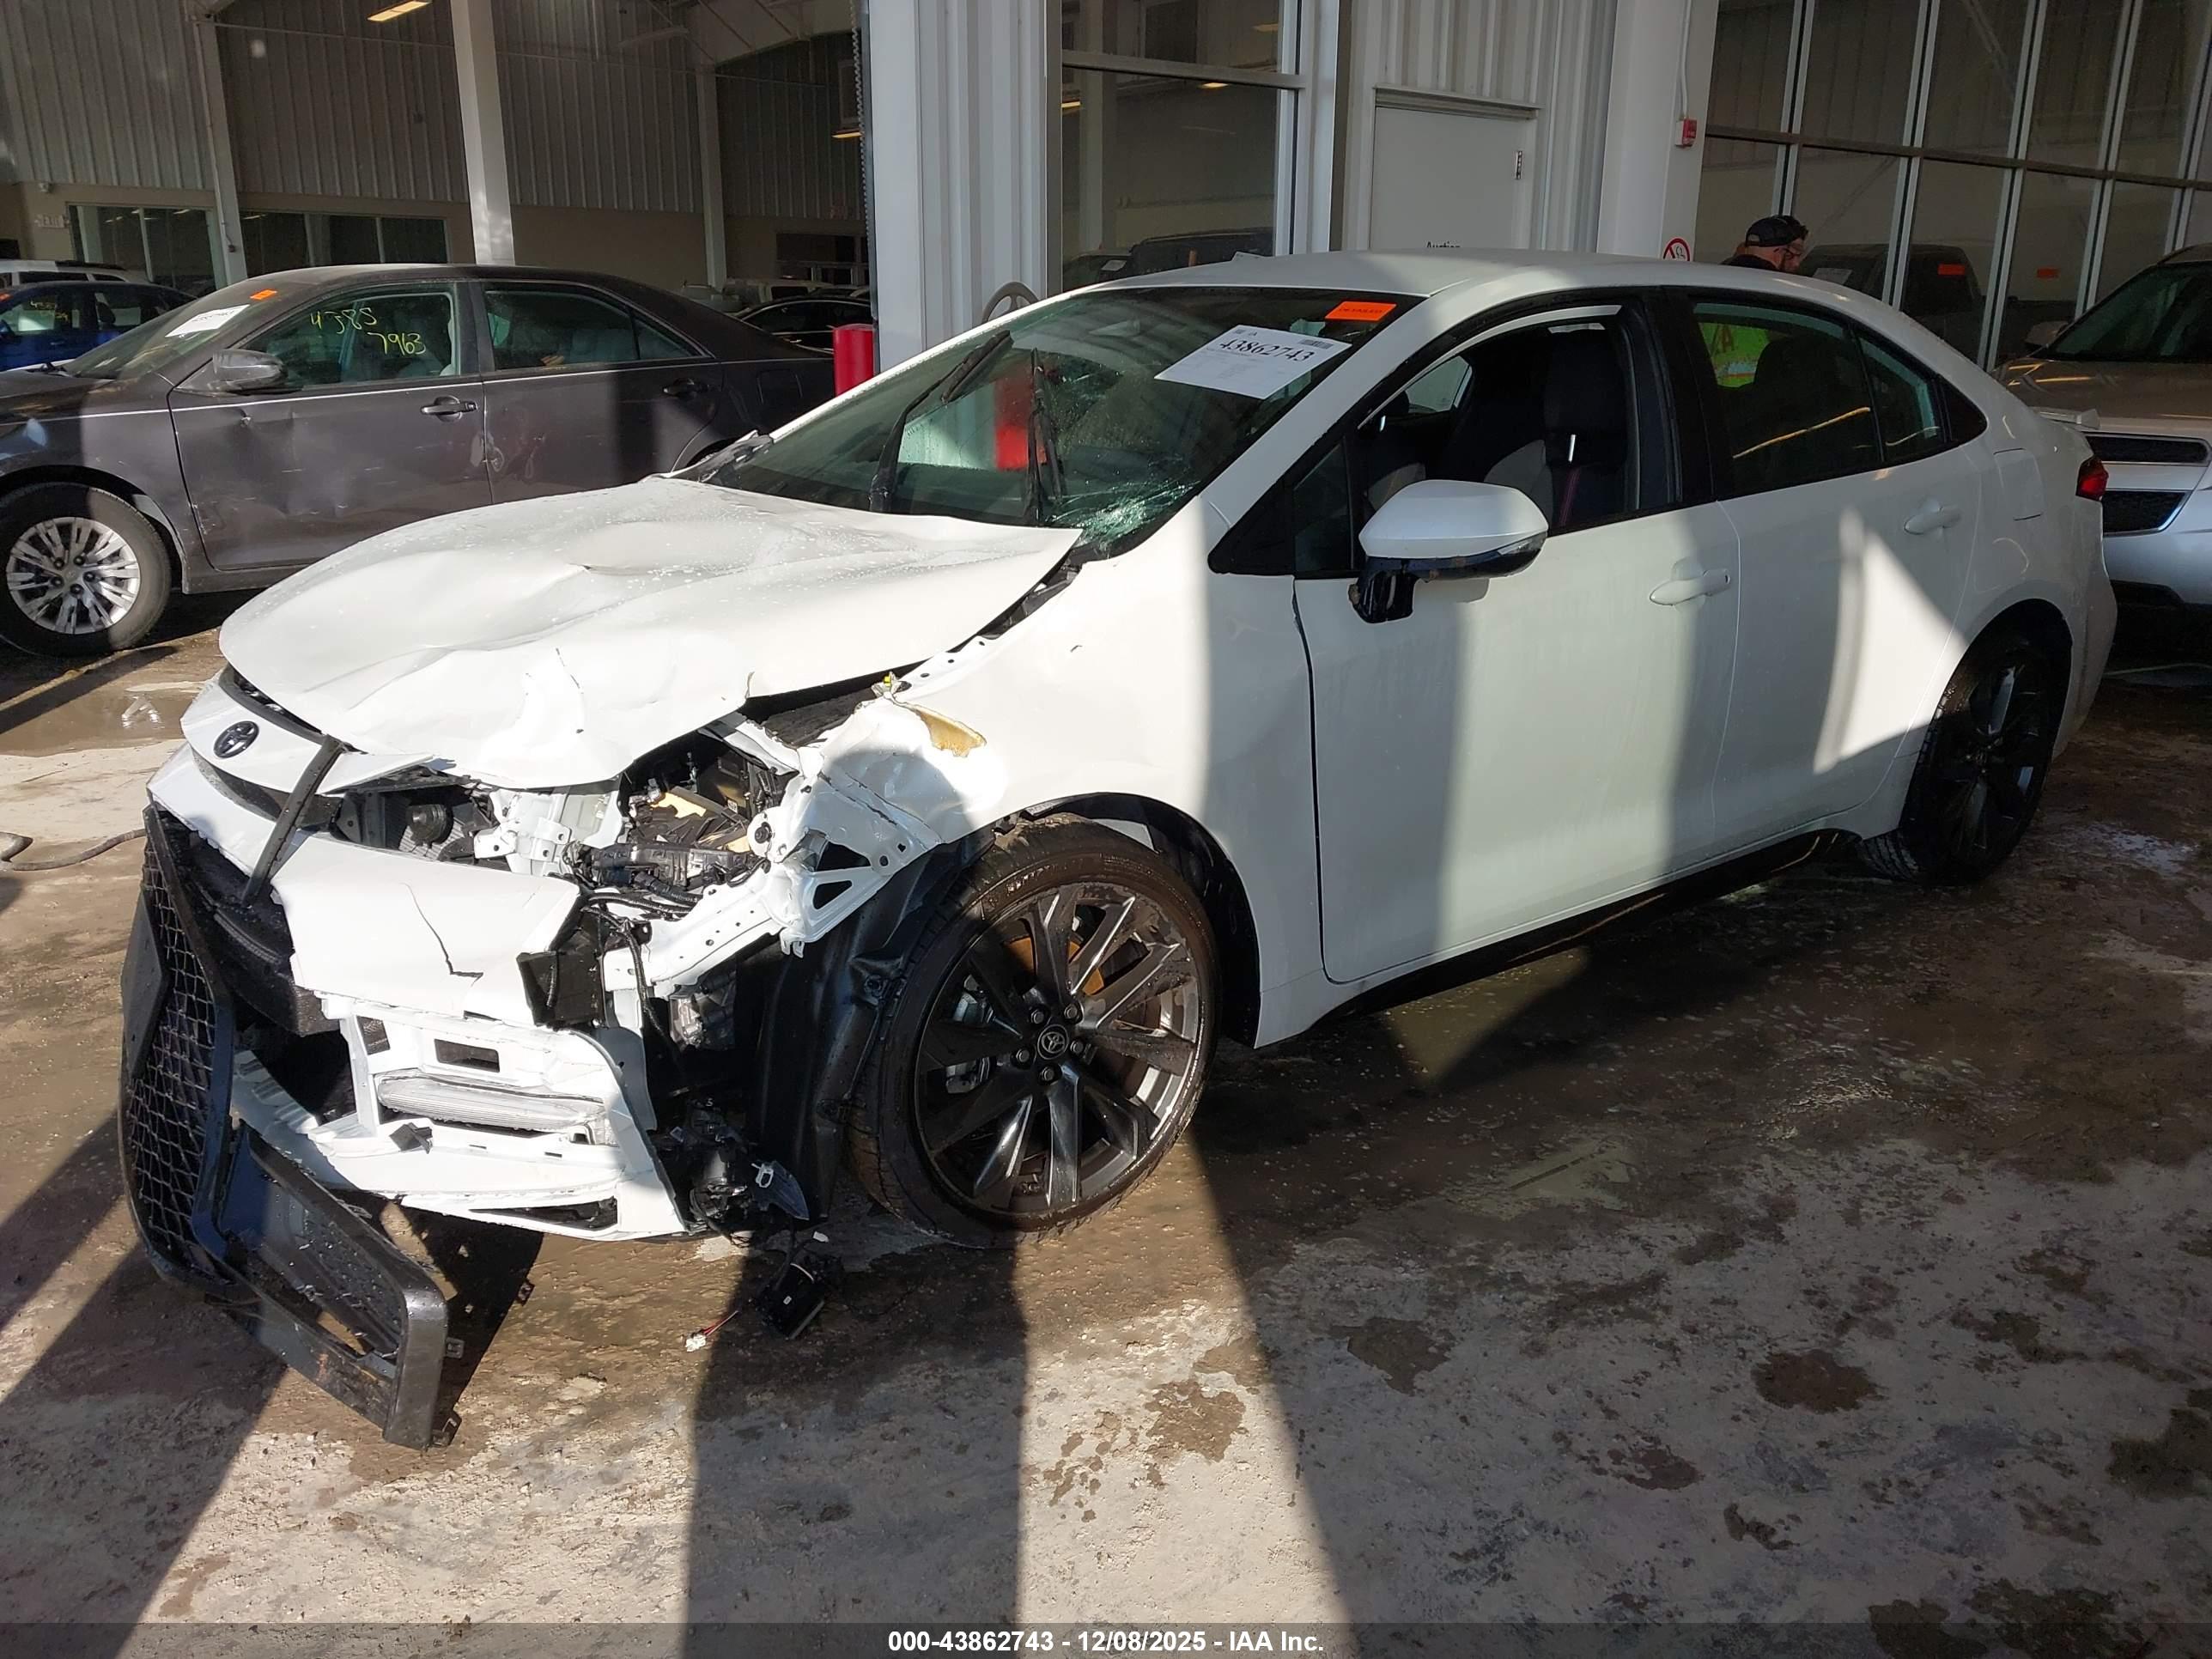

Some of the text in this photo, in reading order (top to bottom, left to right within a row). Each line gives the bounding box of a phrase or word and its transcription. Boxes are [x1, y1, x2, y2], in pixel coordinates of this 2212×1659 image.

[310, 307, 378, 335] 4385
[367, 331, 427, 356] 7963
[1218, 337, 1316, 362] 43862743
